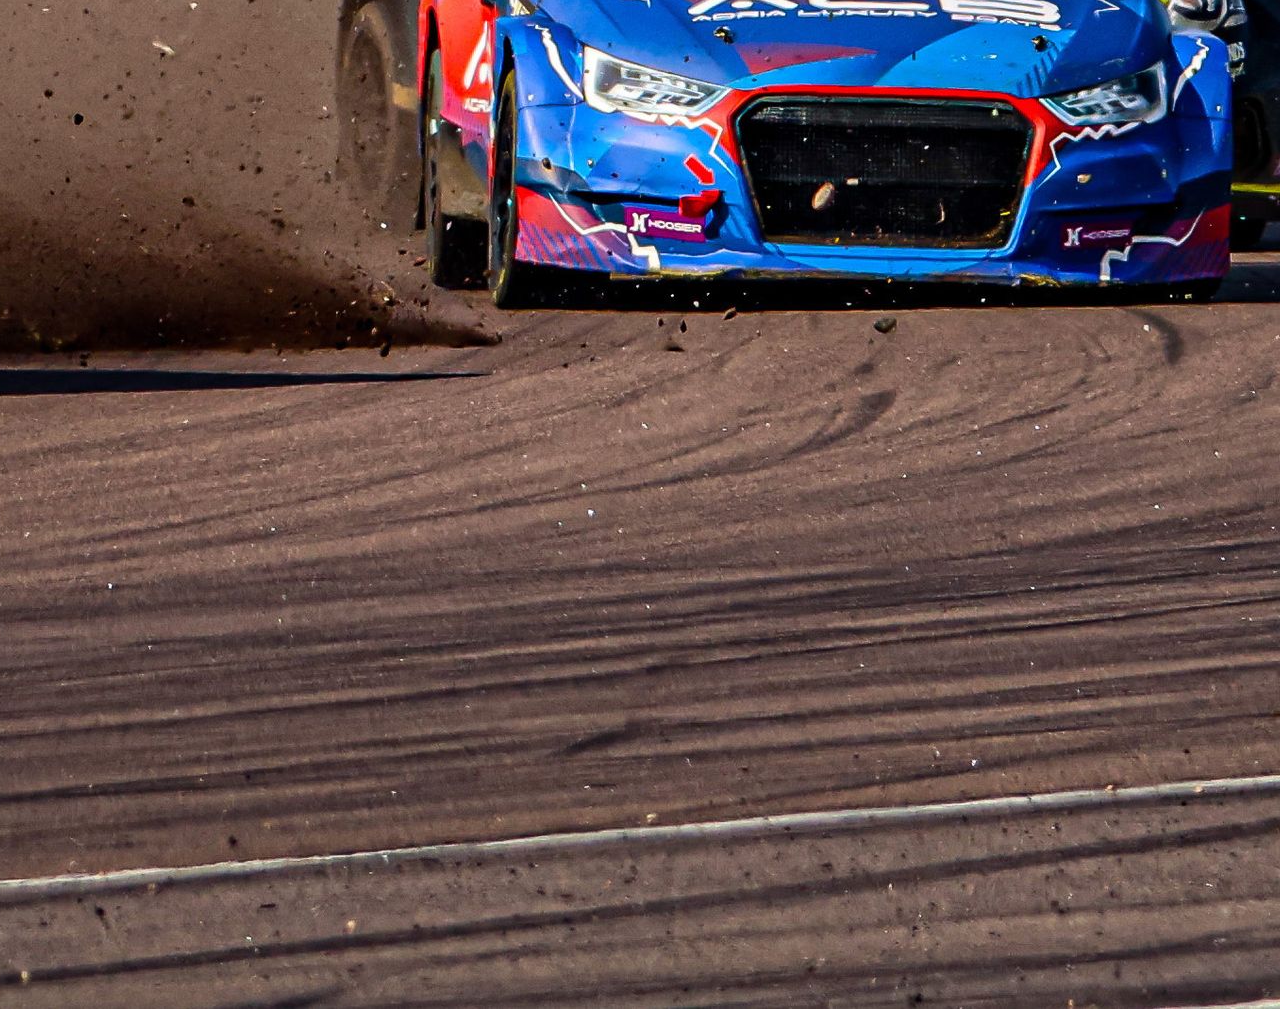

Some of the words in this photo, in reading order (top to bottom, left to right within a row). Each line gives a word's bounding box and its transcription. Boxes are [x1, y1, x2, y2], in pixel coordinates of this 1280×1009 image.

[692, 10, 786, 22] ADRIA
[797, 9, 938, 18] LUXURY
[951, 13, 1062, 31] BOATS
[648, 218, 702, 234] HOOSIER
